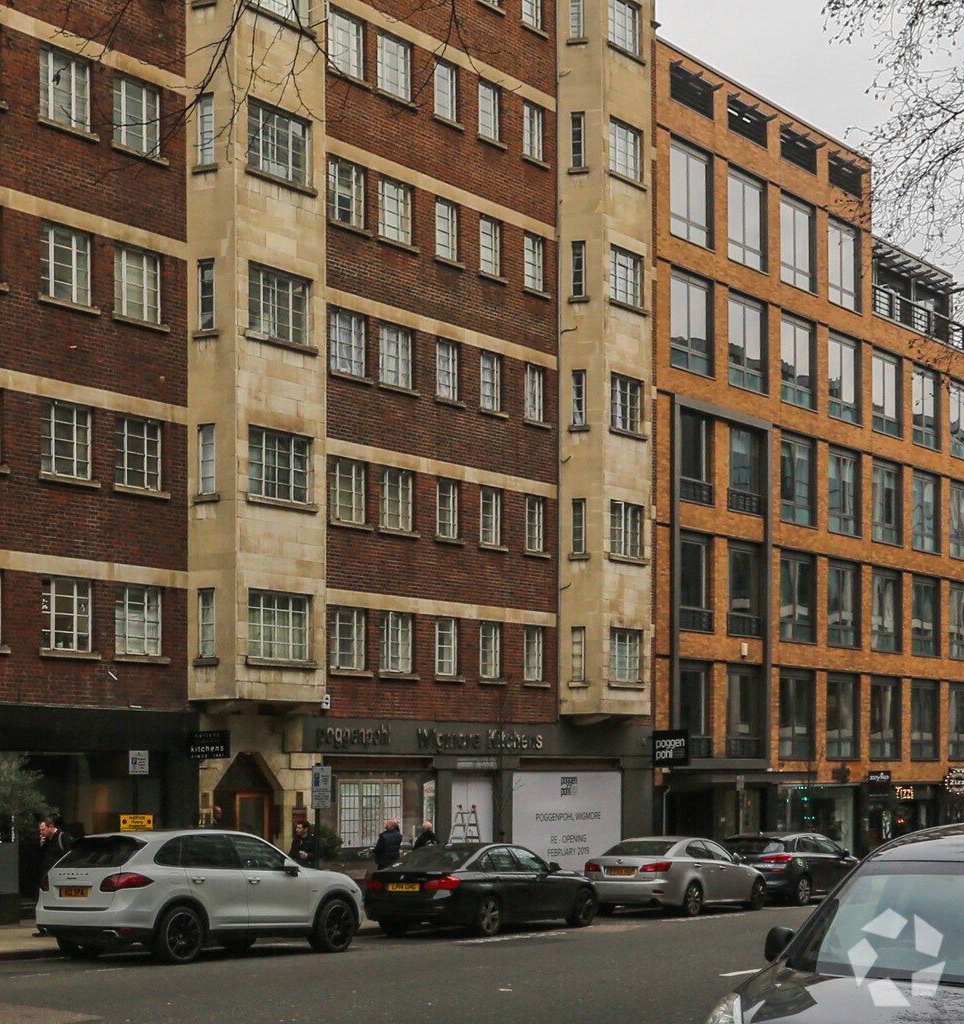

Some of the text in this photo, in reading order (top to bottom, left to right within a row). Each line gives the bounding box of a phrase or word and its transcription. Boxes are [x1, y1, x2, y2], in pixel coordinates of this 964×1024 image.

[417, 728, 543, 753] Wigmore Kitchens
[656, 738, 685, 750] poggen
[190, 745, 225, 753] kitchens
[656, 749, 673, 761] pohl
[560, 776, 578, 787] poggen
[560, 786, 572, 798] pohl
[535, 811, 602, 823] POGGENPOHL WIGMORE
[550, 835, 558, 845] RE
[562, 834, 587, 844] OPENING
[547, 846, 590, 857] FEBRUARY 2019
